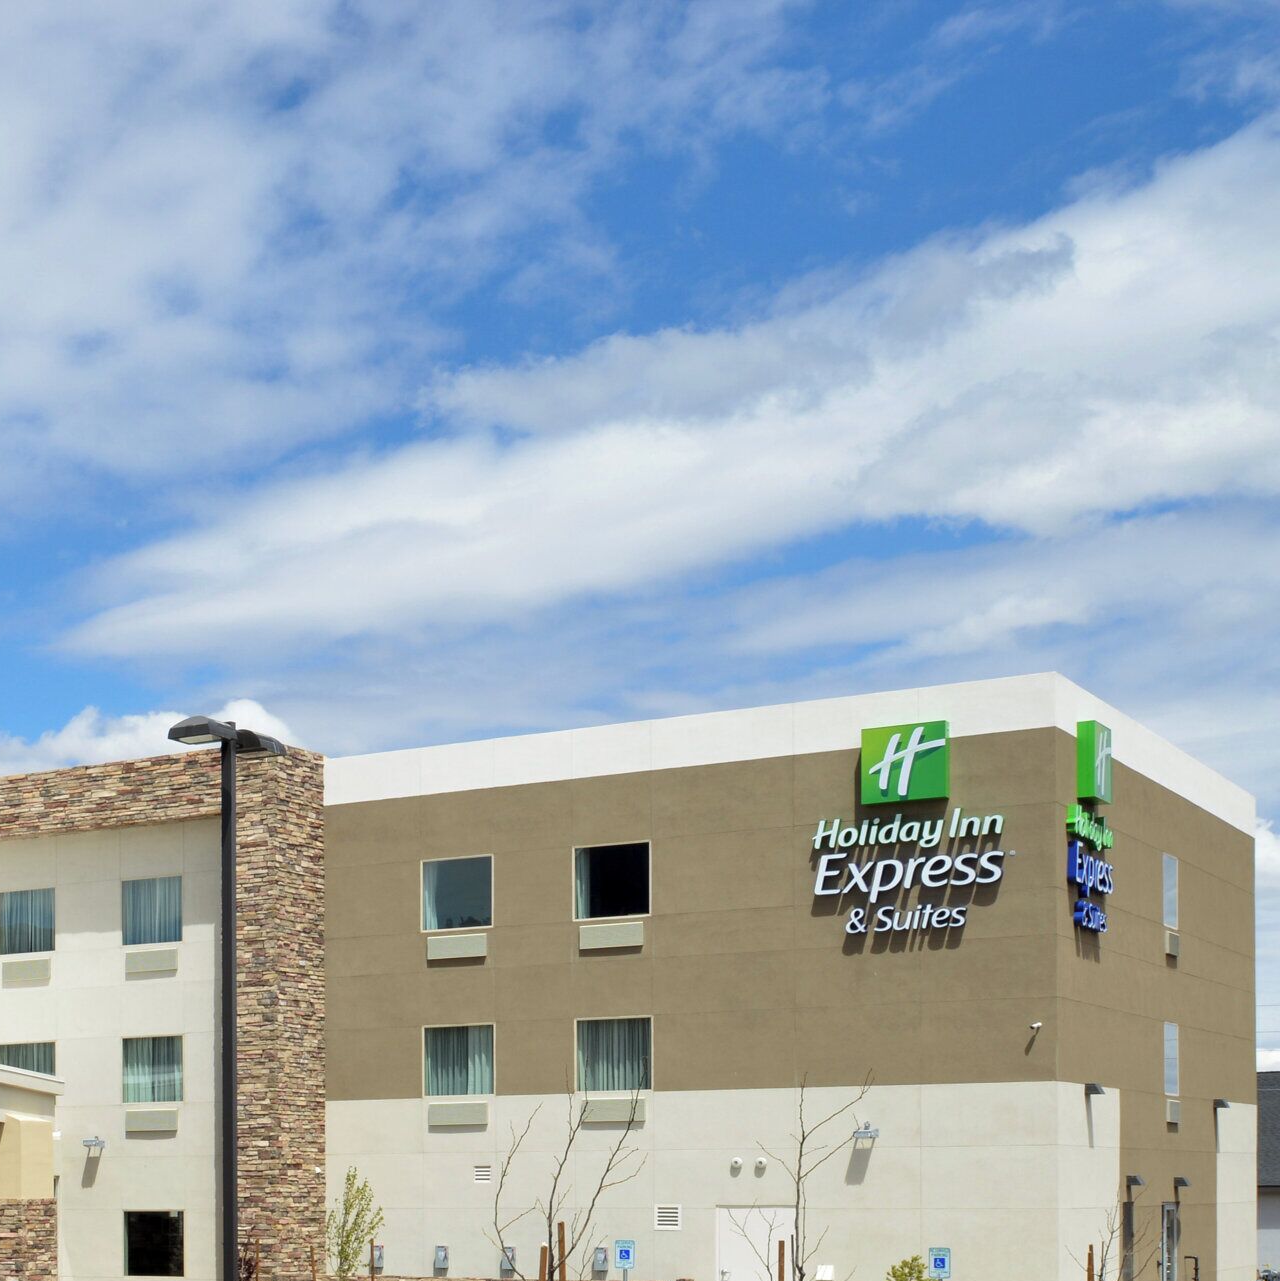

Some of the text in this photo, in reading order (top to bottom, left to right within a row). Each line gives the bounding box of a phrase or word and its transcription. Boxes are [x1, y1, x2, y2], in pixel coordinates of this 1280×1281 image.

[812, 807, 1005, 849] Holiday Inn
[813, 850, 1006, 904] Express
[1075, 840, 1114, 898] Express
[845, 903, 967, 934] & Suites
